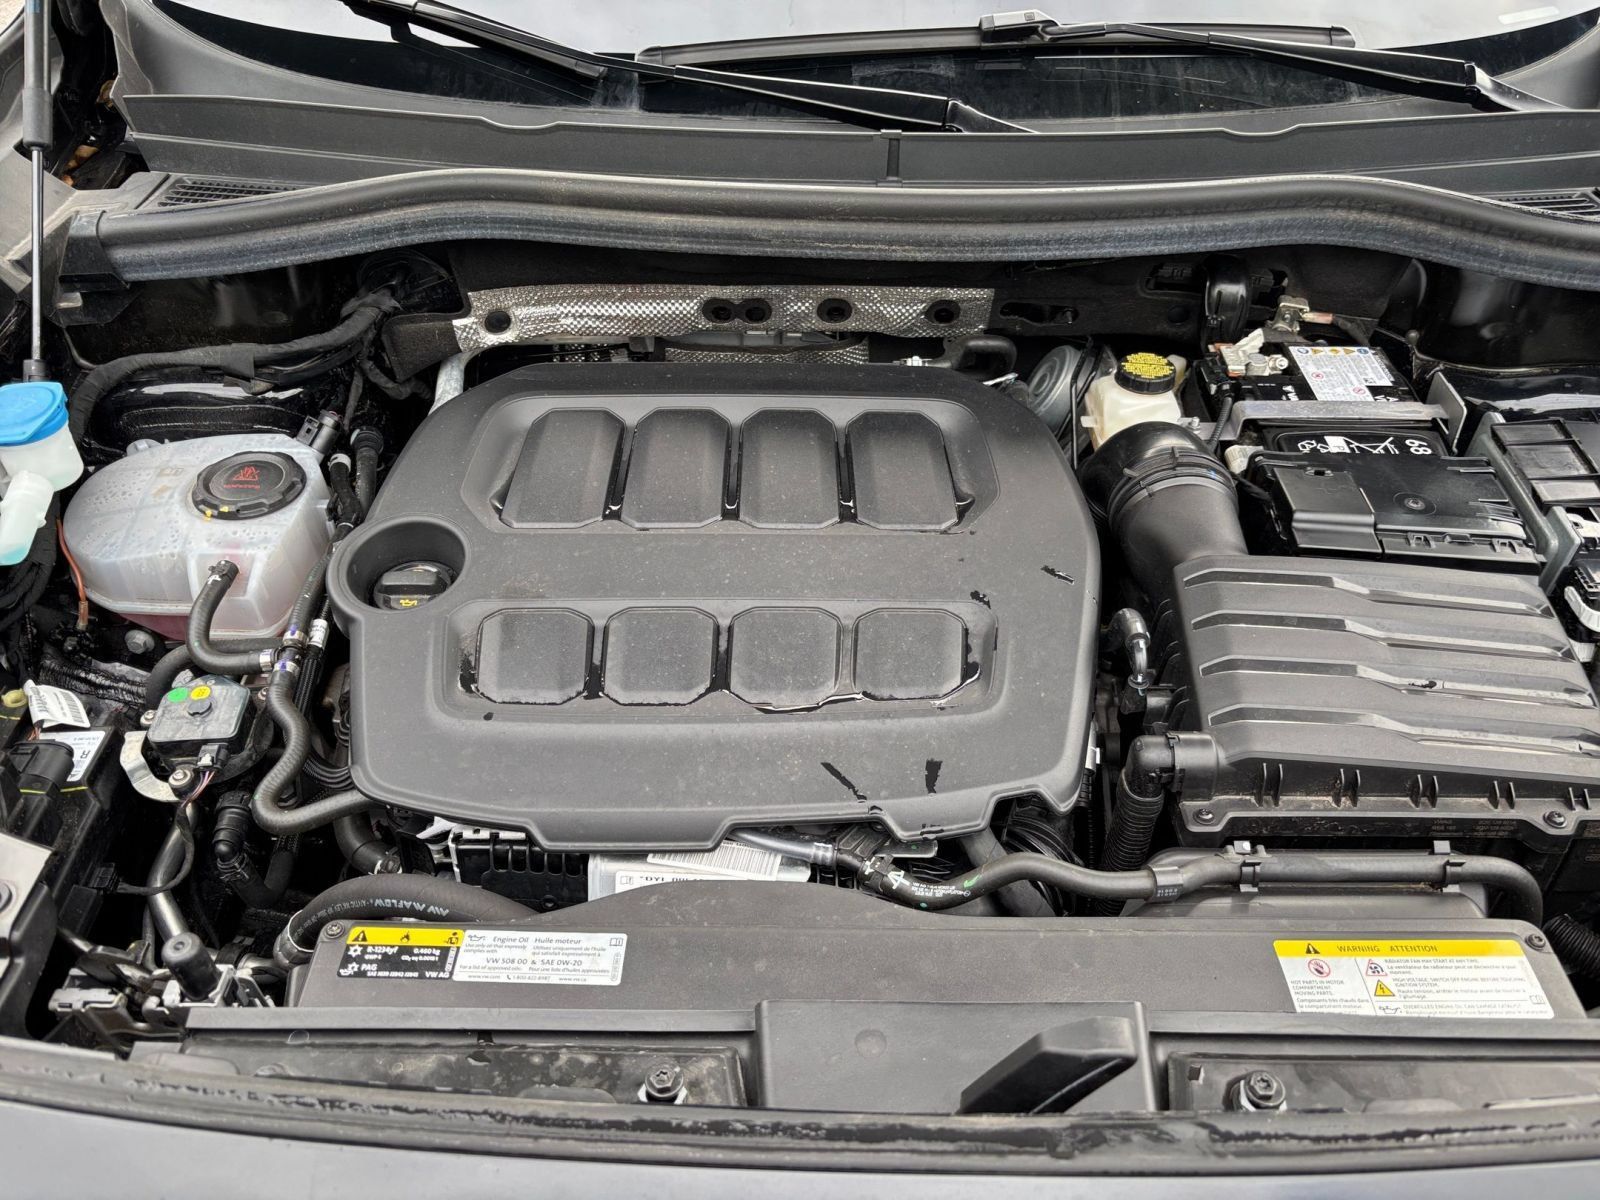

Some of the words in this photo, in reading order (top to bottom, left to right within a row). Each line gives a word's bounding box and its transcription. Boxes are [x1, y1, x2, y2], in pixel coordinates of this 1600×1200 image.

[1405, 439, 1431, 455] 68
[493, 936, 517, 944] Engine
[1337, 945, 1380, 953] WARNING
[1390, 945, 1438, 953] ATTENTION
[360, 963, 378, 971] PAG
[438, 971, 450, 979] AG
